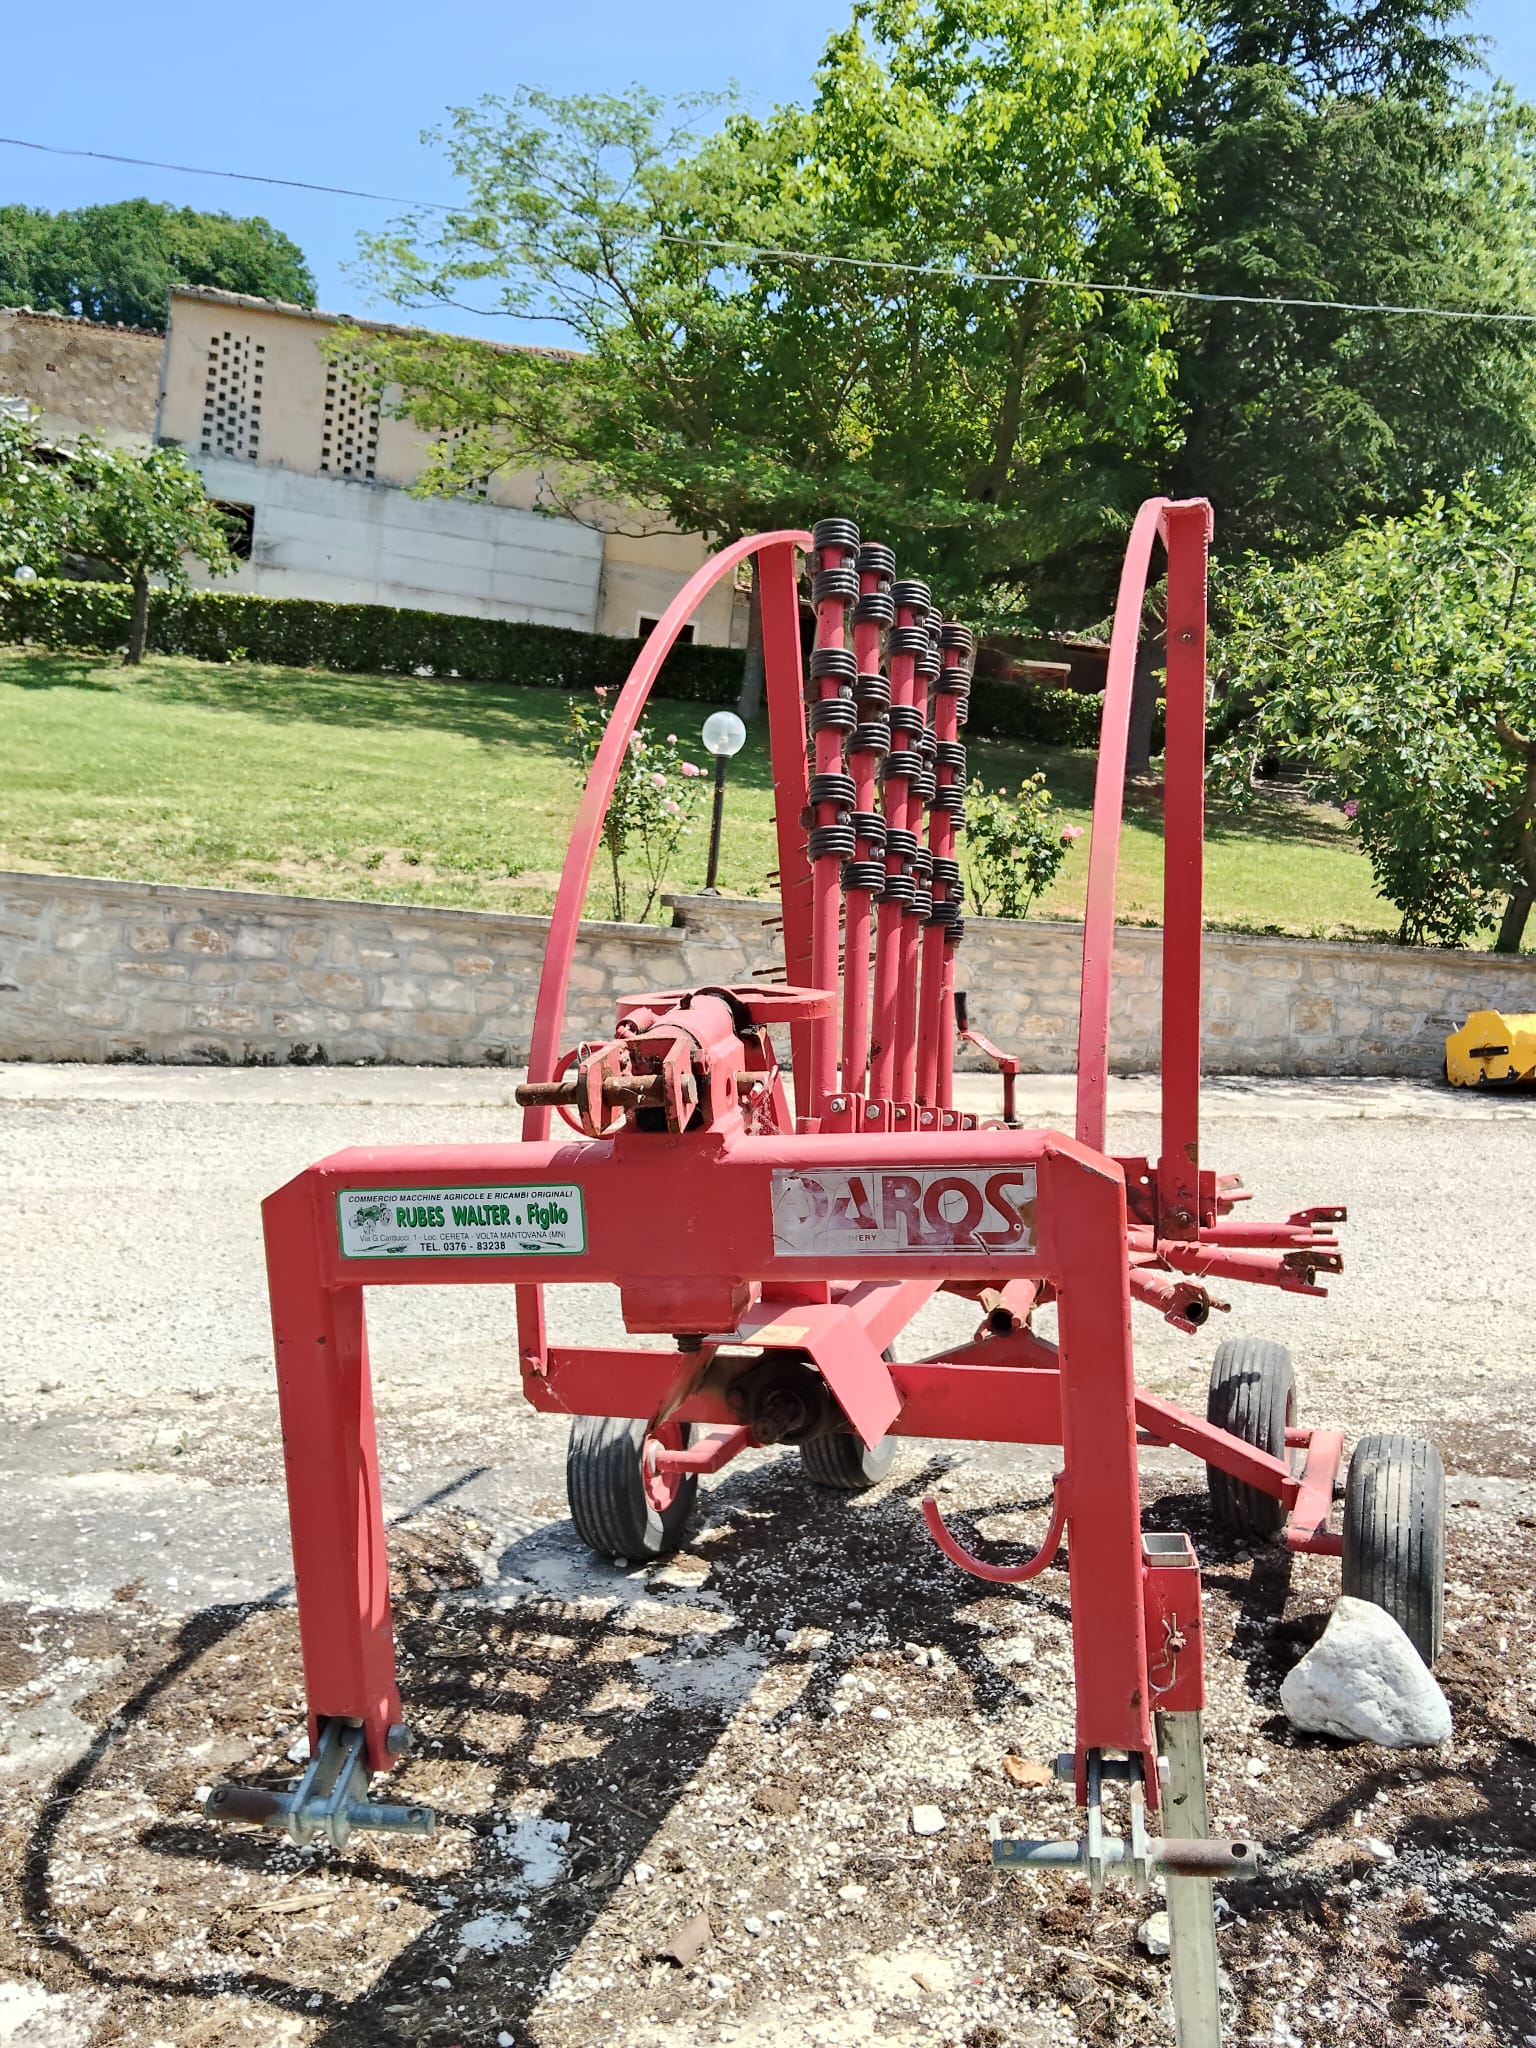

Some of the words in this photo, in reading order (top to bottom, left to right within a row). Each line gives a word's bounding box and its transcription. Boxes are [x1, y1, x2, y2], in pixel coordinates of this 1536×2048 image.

[348, 1195, 397, 1203] COMMERCIO
[399, 1194, 441, 1202] MACCHINE
[487, 1192, 493, 1200] E
[495, 1191, 529, 1199] RICAMBI
[531, 1190, 573, 1198] ORIGINALI
[397, 1206, 445, 1228] RUBES
[452, 1204, 510, 1226] WALTER
[515, 1215, 522, 1226] e
[527, 1202, 568, 1230] Figlio
[360, 1235, 371, 1243] Via
[439, 1232, 470, 1241] CERETA
[500, 1231, 547, 1239] MANTOVANA
[549, 1231, 567, 1239] (MN)
[420, 1242, 440, 1251] TEL.
[443, 1241, 467, 1251] 0376
[476, 1241, 506, 1250] 83238
